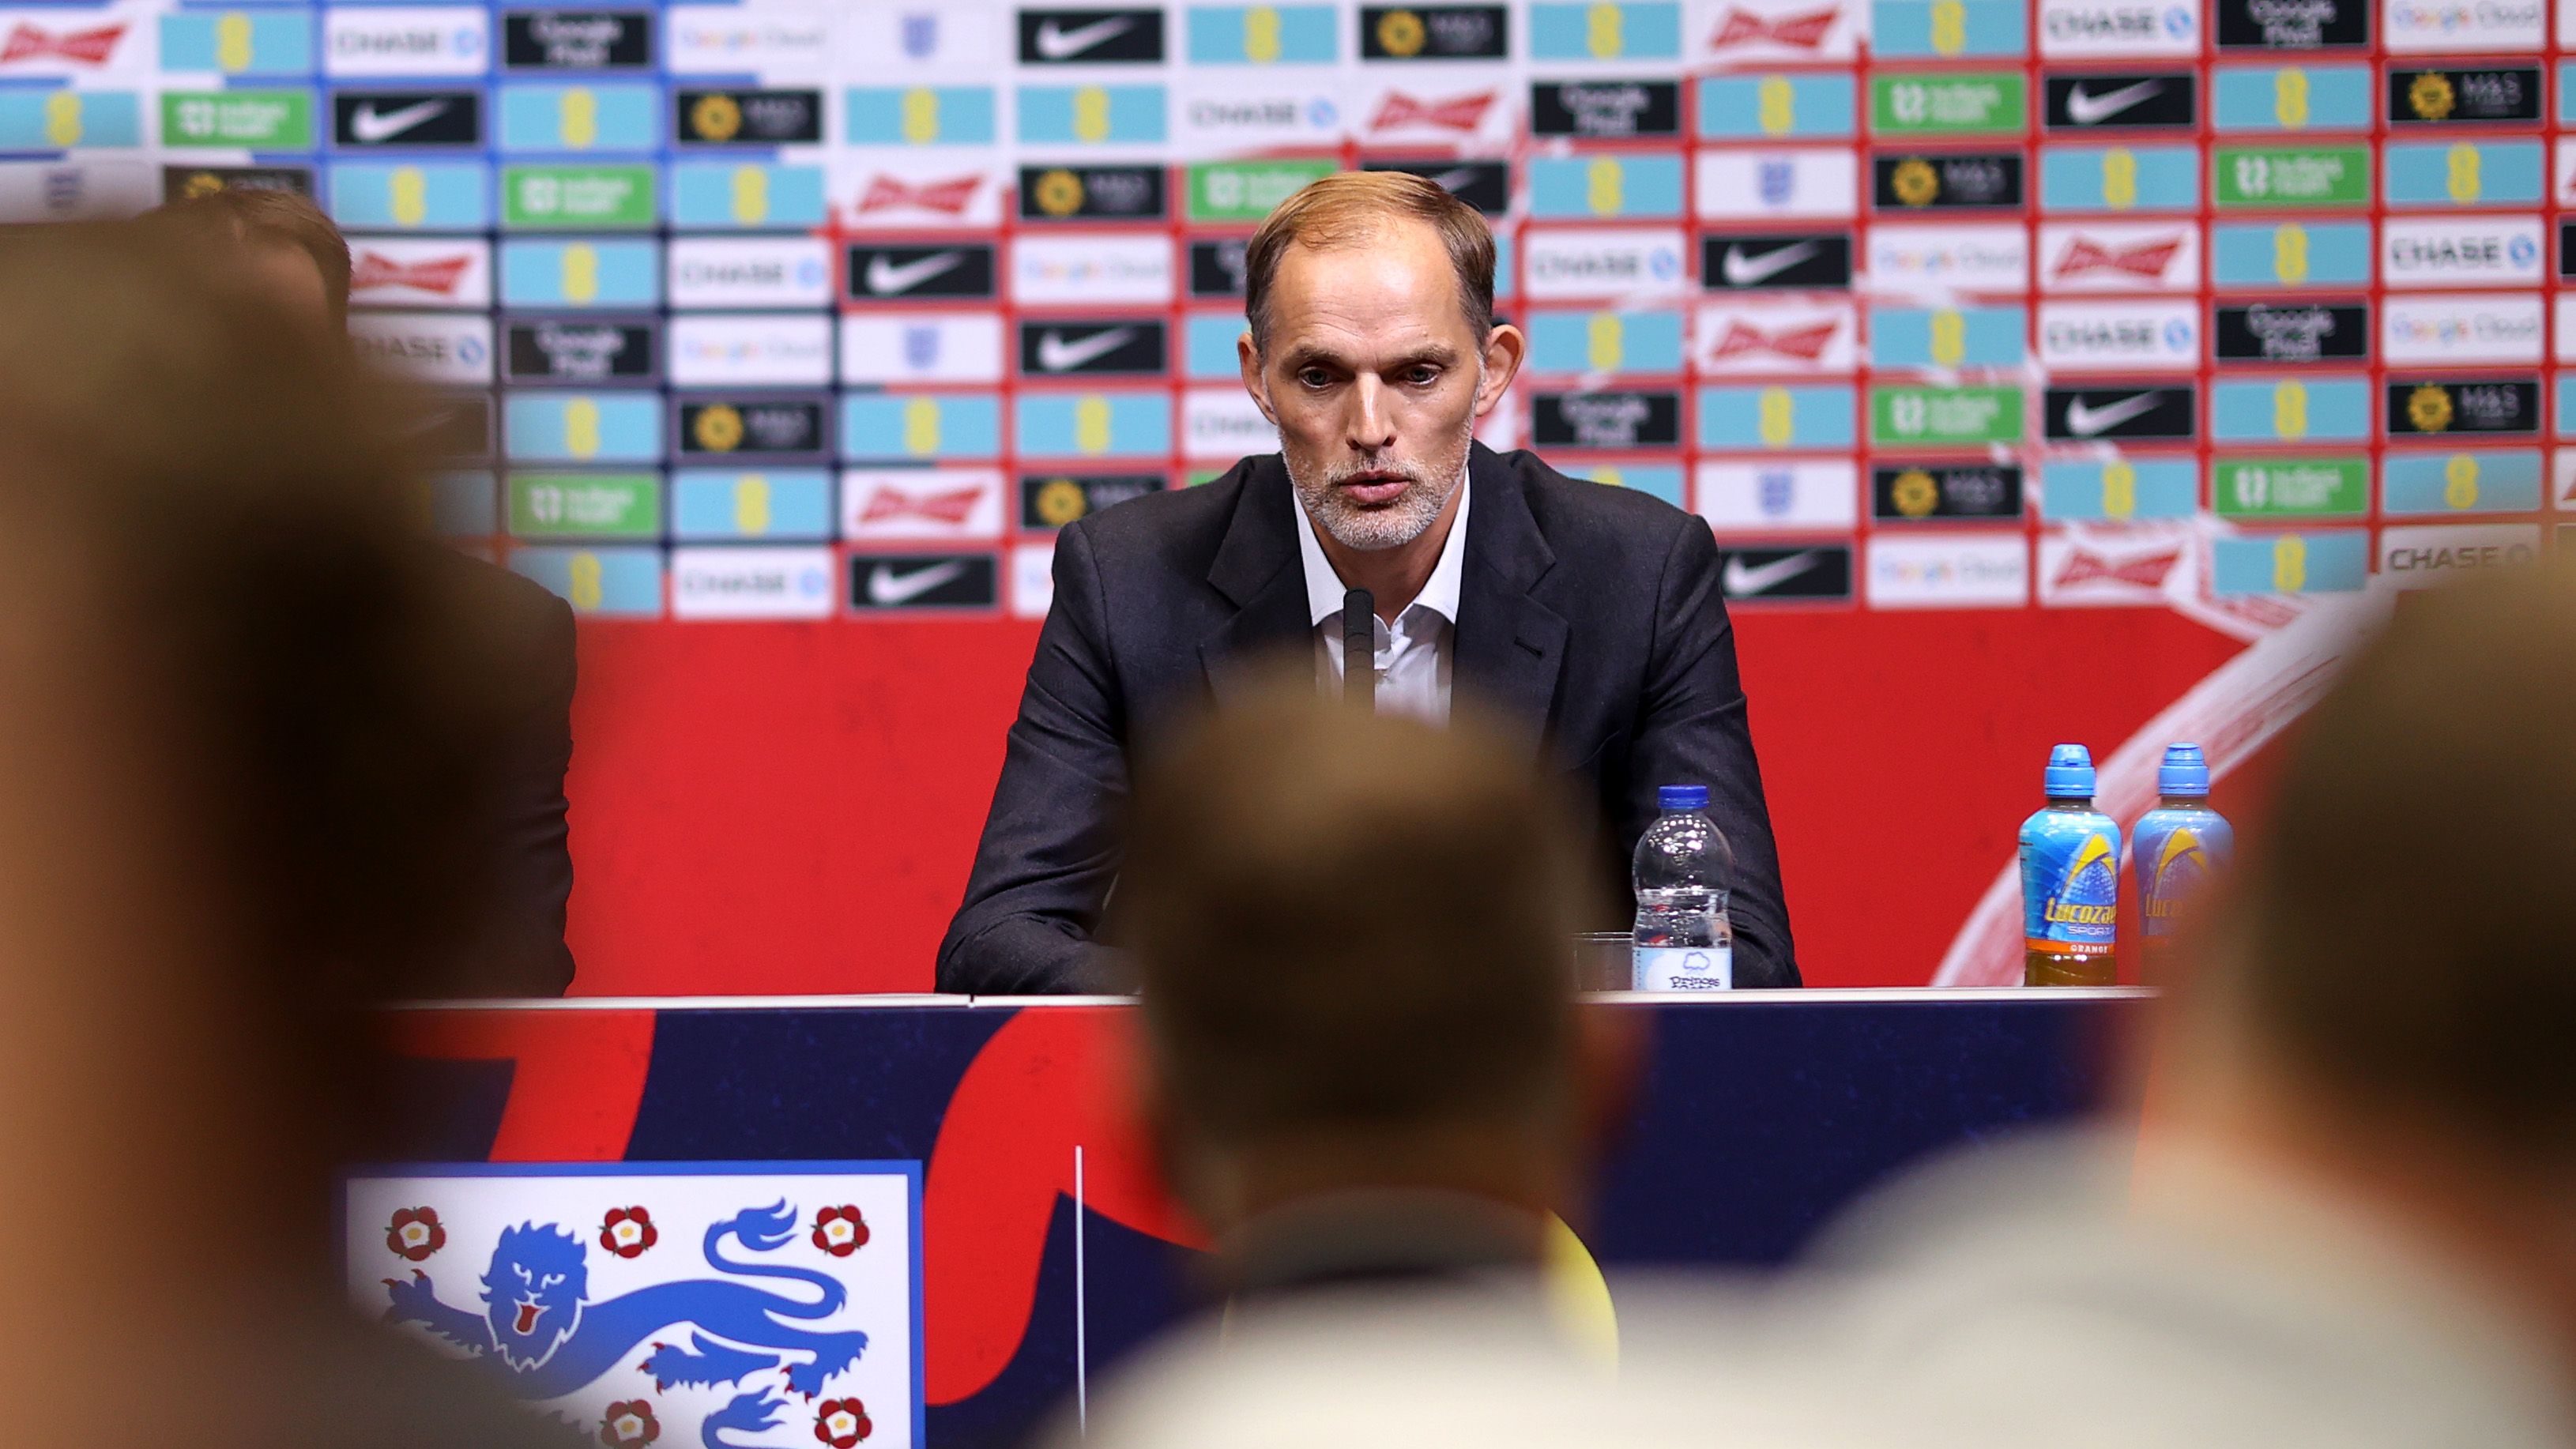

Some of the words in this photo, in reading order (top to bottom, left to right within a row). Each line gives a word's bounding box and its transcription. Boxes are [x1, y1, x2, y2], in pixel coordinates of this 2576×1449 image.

[2047, 7, 2156, 38] CHASE
[1534, 250, 1638, 279] CHASE
[2391, 236, 2501, 267] CHASE
[2047, 319, 2156, 352] CHASE
[2389, 545, 2499, 570] CHASE
[2067, 926, 2111, 935] SPORT
